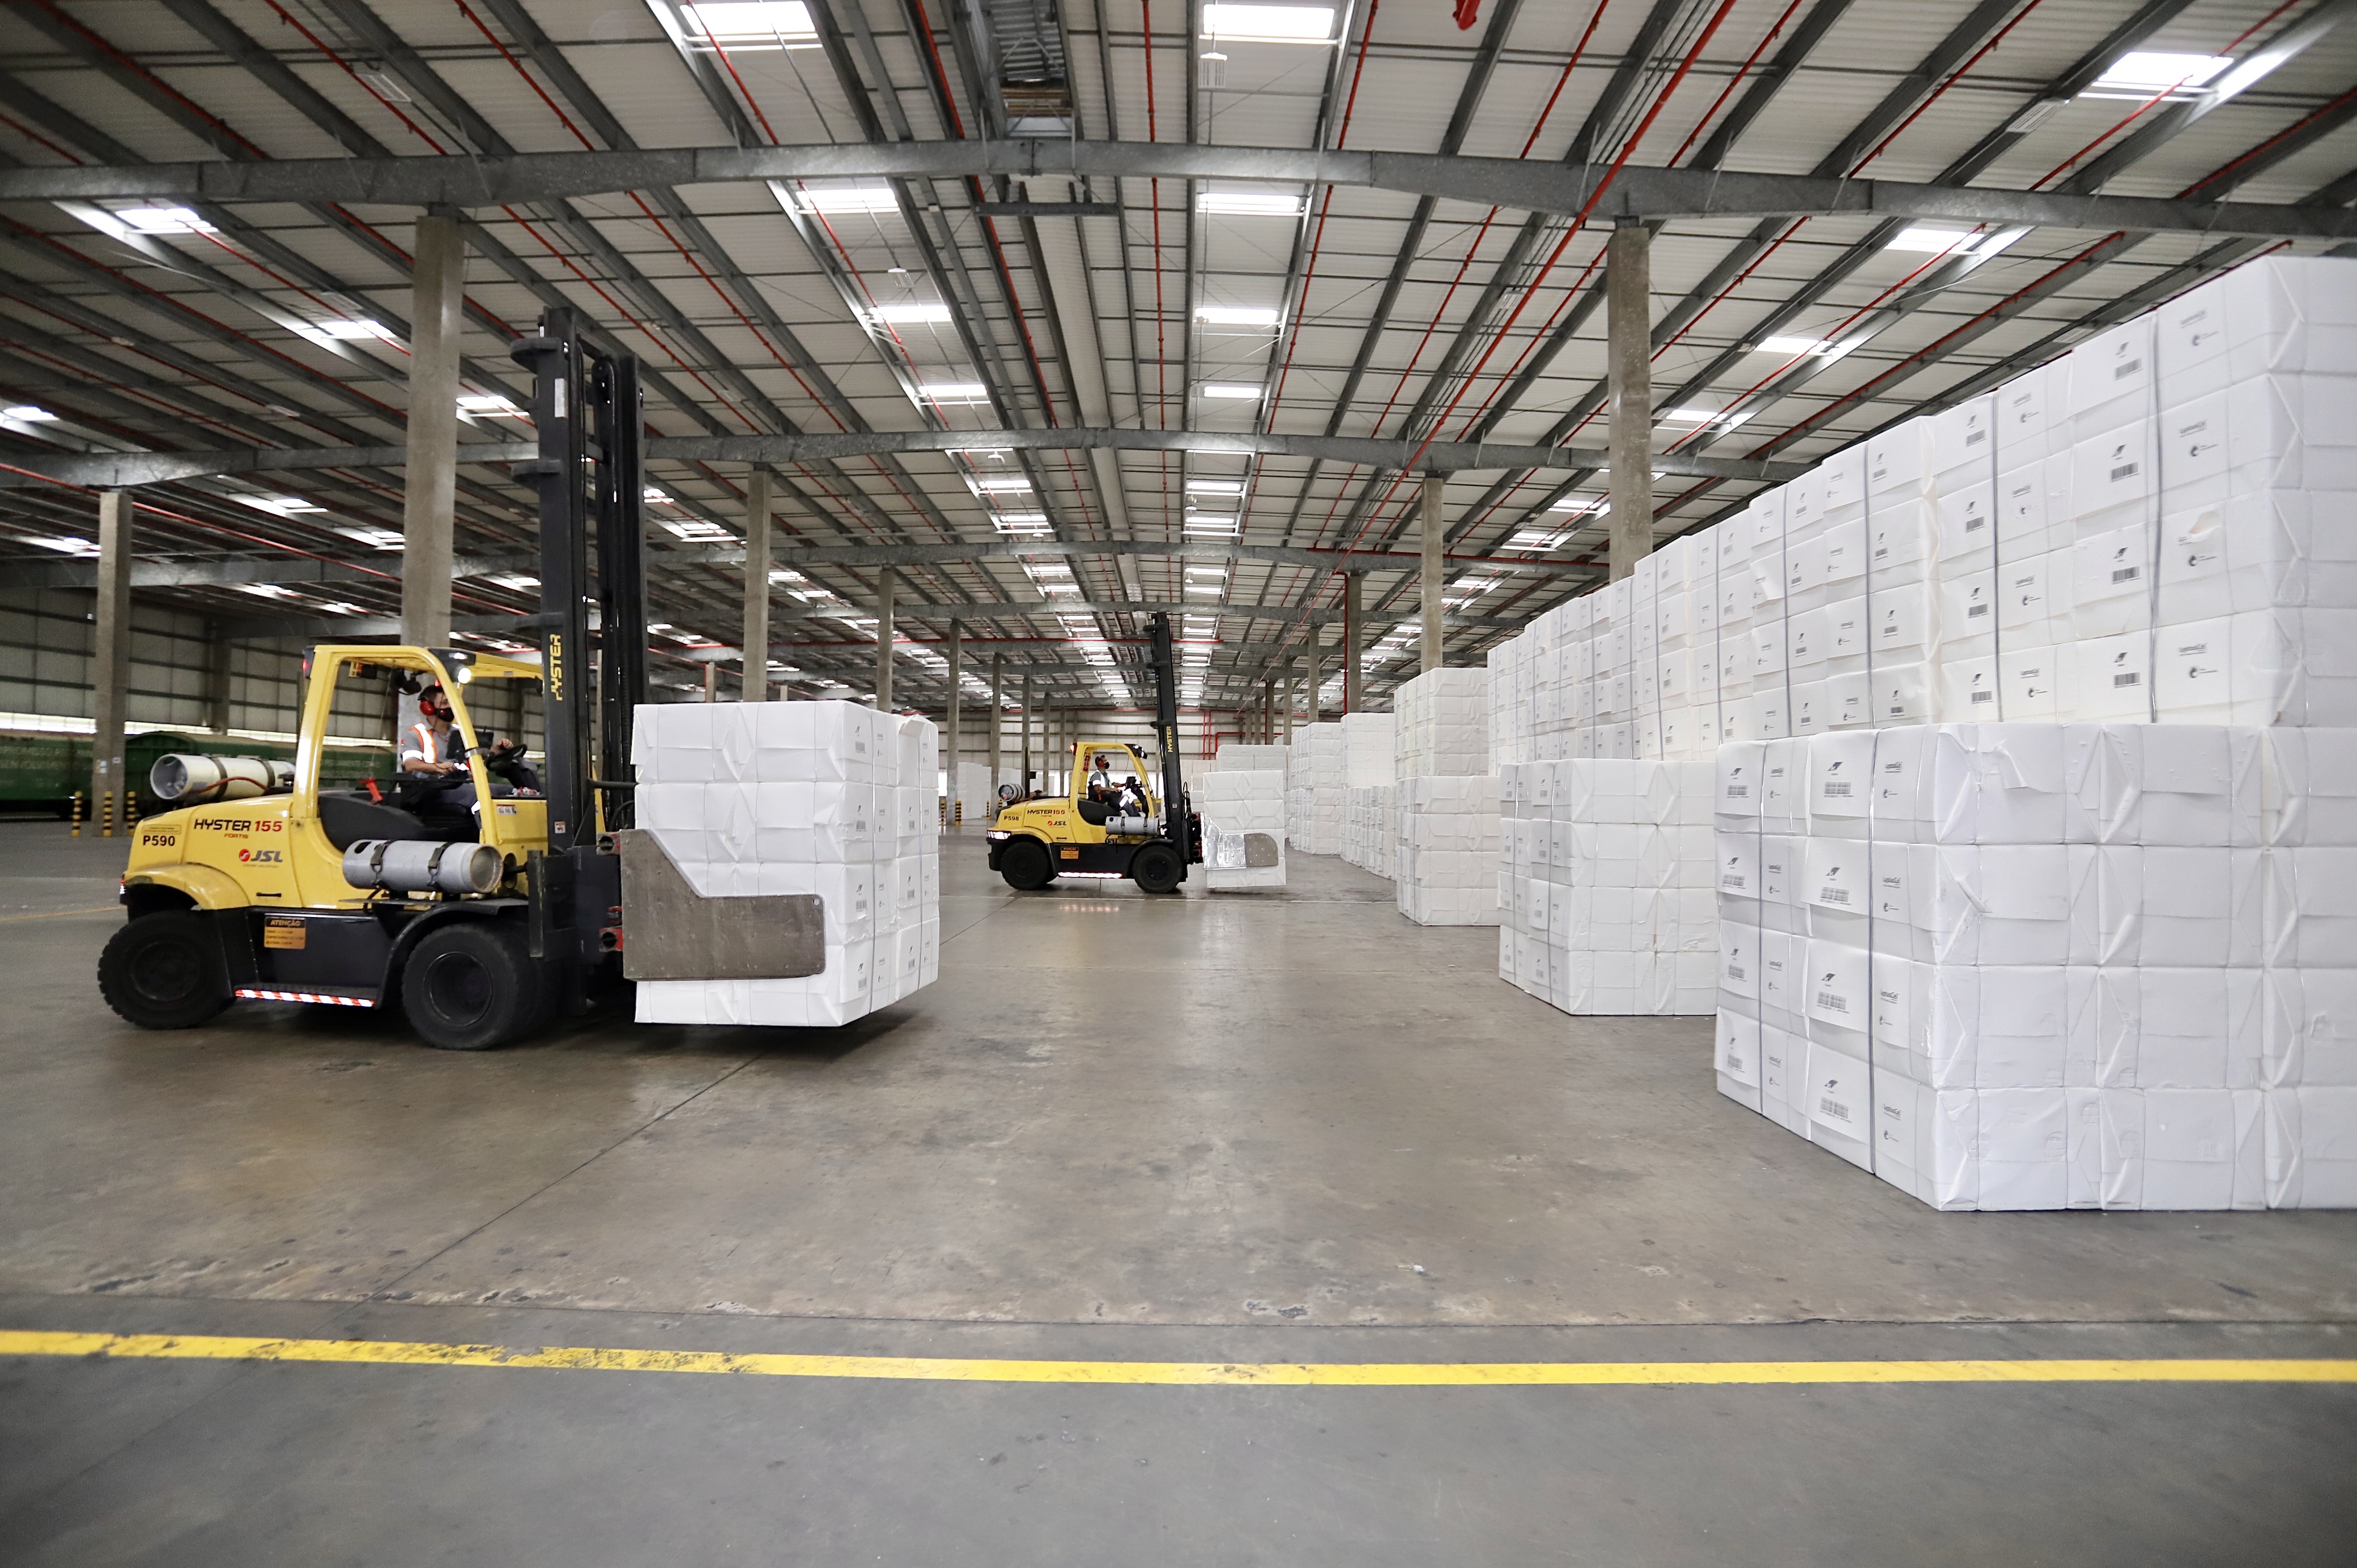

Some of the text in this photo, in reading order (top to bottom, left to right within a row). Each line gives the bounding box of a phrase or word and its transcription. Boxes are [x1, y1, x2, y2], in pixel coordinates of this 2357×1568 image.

[194, 819, 283, 832] HYSTER 155
[143, 835, 176, 846] P590
[250, 850, 283, 862] JSL
